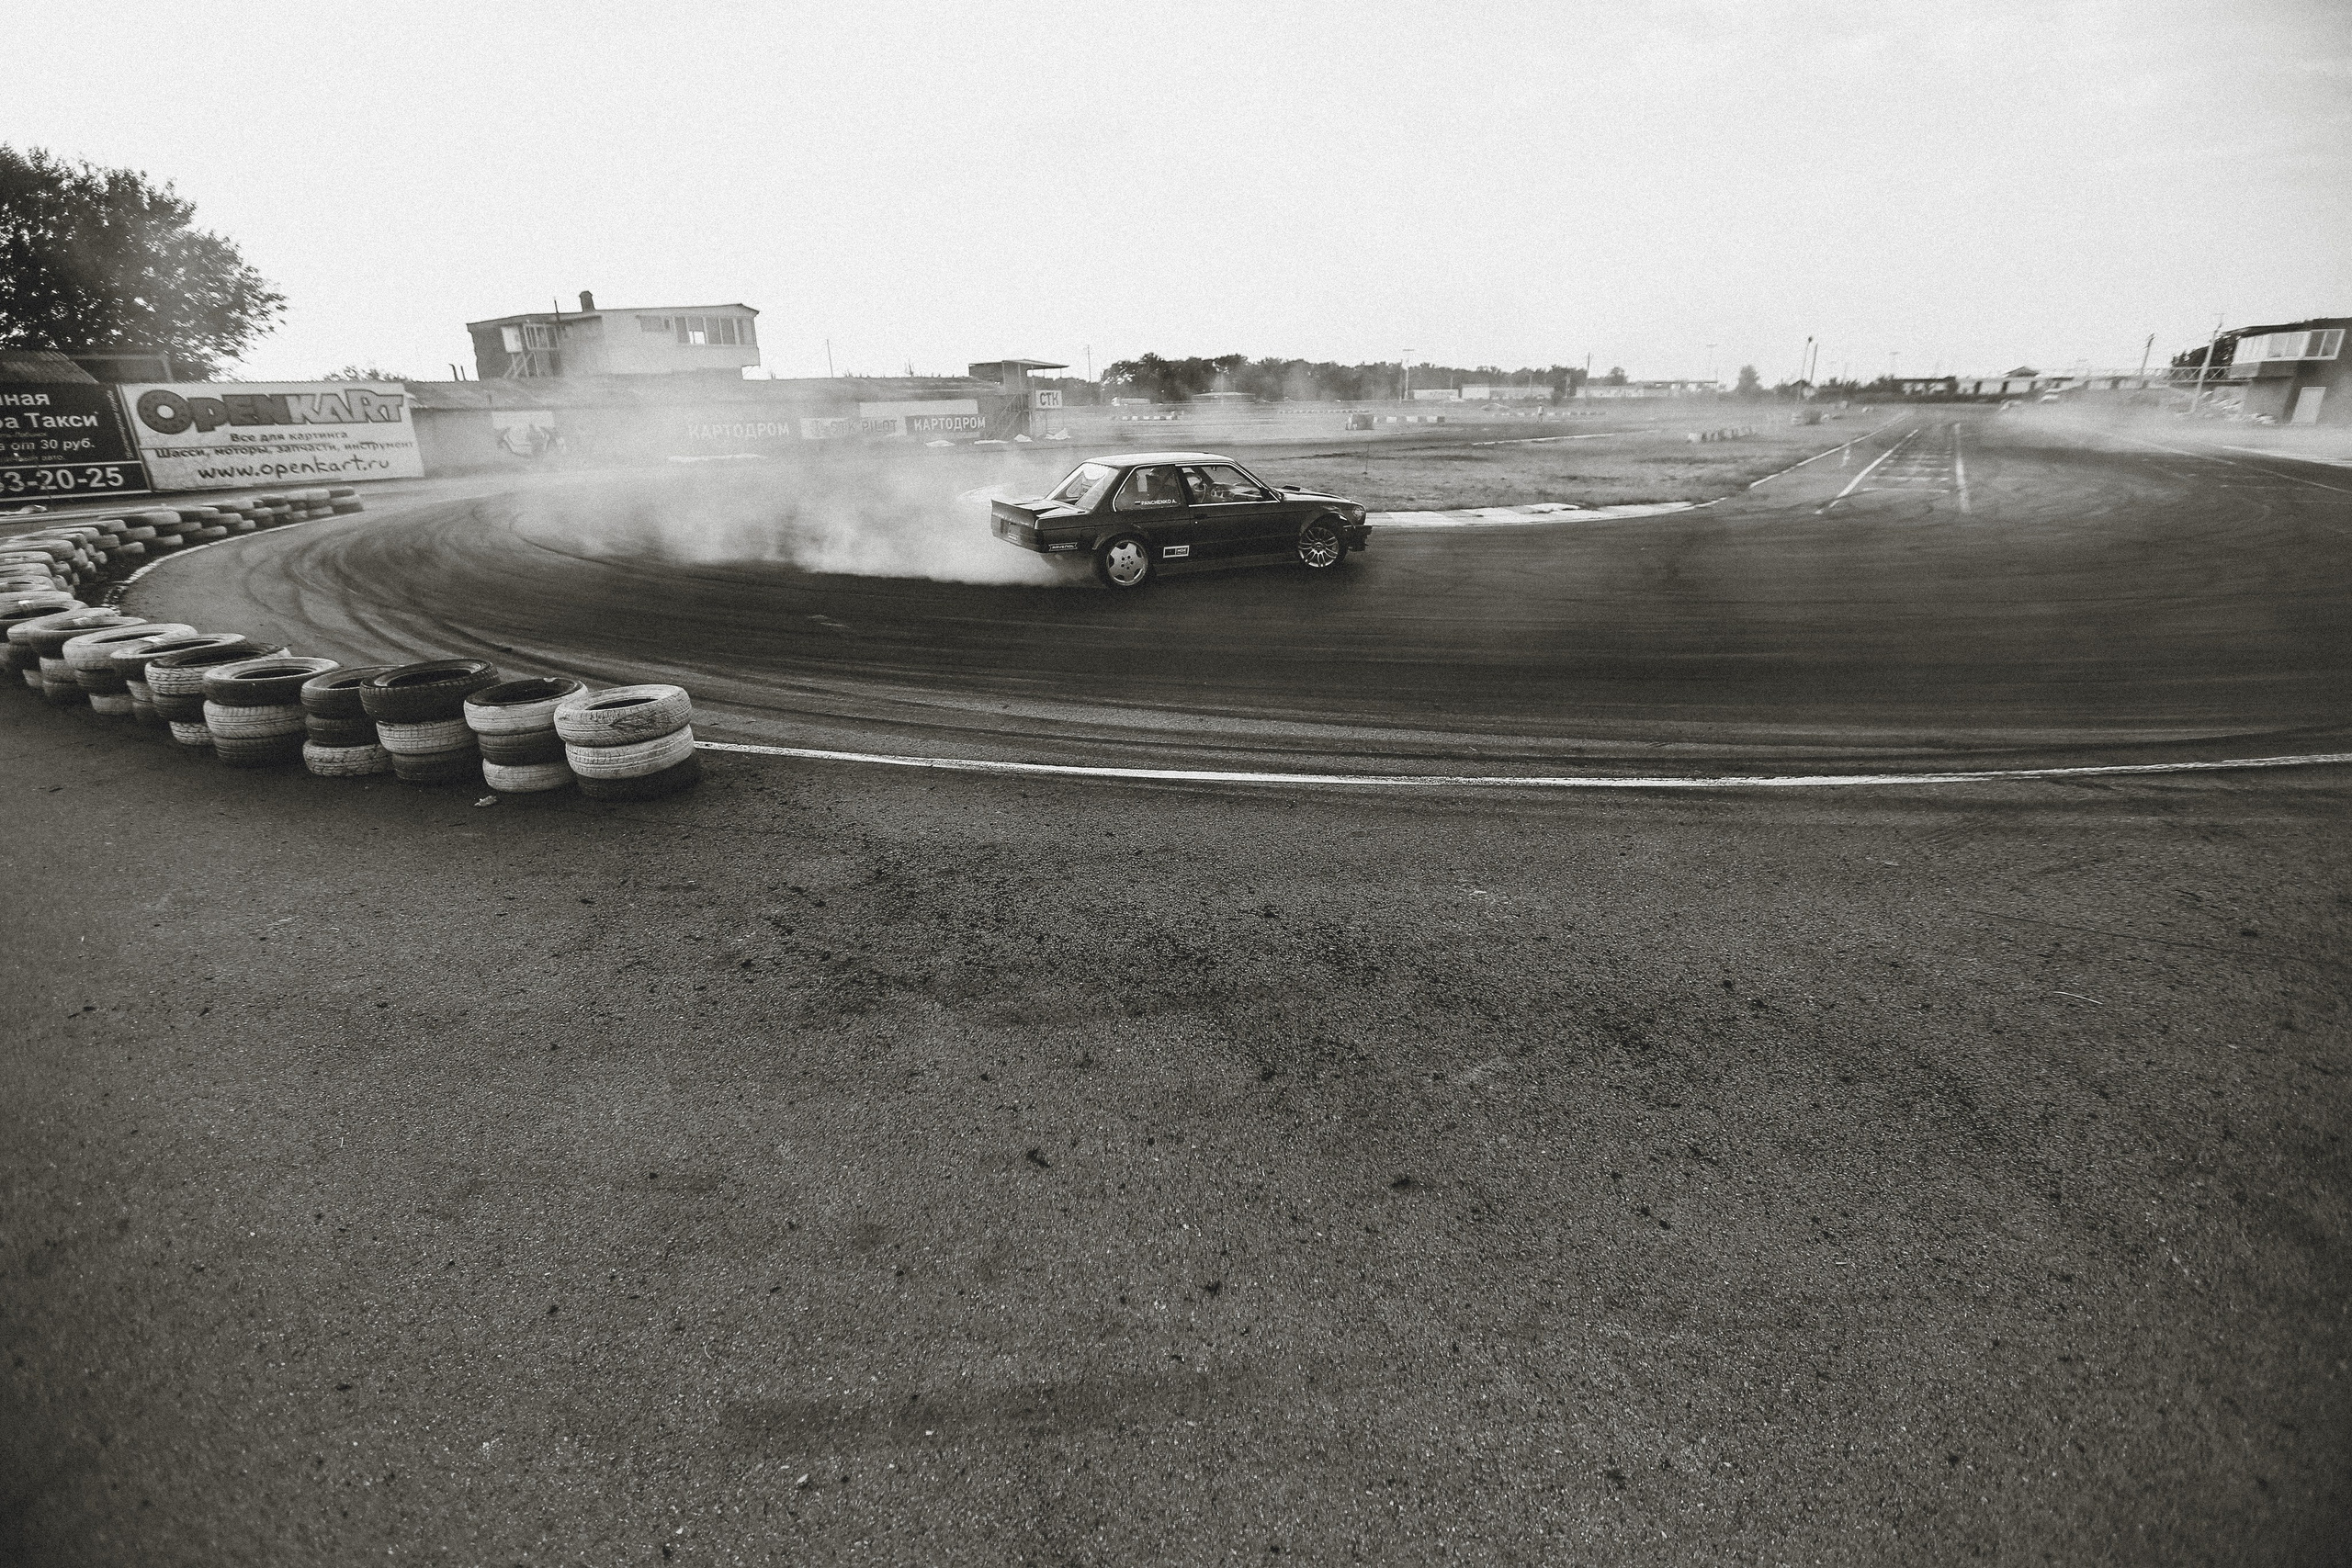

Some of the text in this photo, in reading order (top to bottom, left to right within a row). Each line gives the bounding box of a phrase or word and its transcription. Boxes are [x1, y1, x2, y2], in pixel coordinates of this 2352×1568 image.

[1039, 392, 1059, 406] СТК
[24, 412, 98, 428] Такси
[862, 419, 898, 434] PILOT
[913, 416, 986, 431] КАРТОДРОМ
[231, 431, 348, 443] Все для картинга
[689, 423, 790, 440] КАРТОДРОМ
[40, 439, 59, 450] 30
[62, 437, 96, 451] руб.
[198, 454, 390, 479] www.openkart.ru
